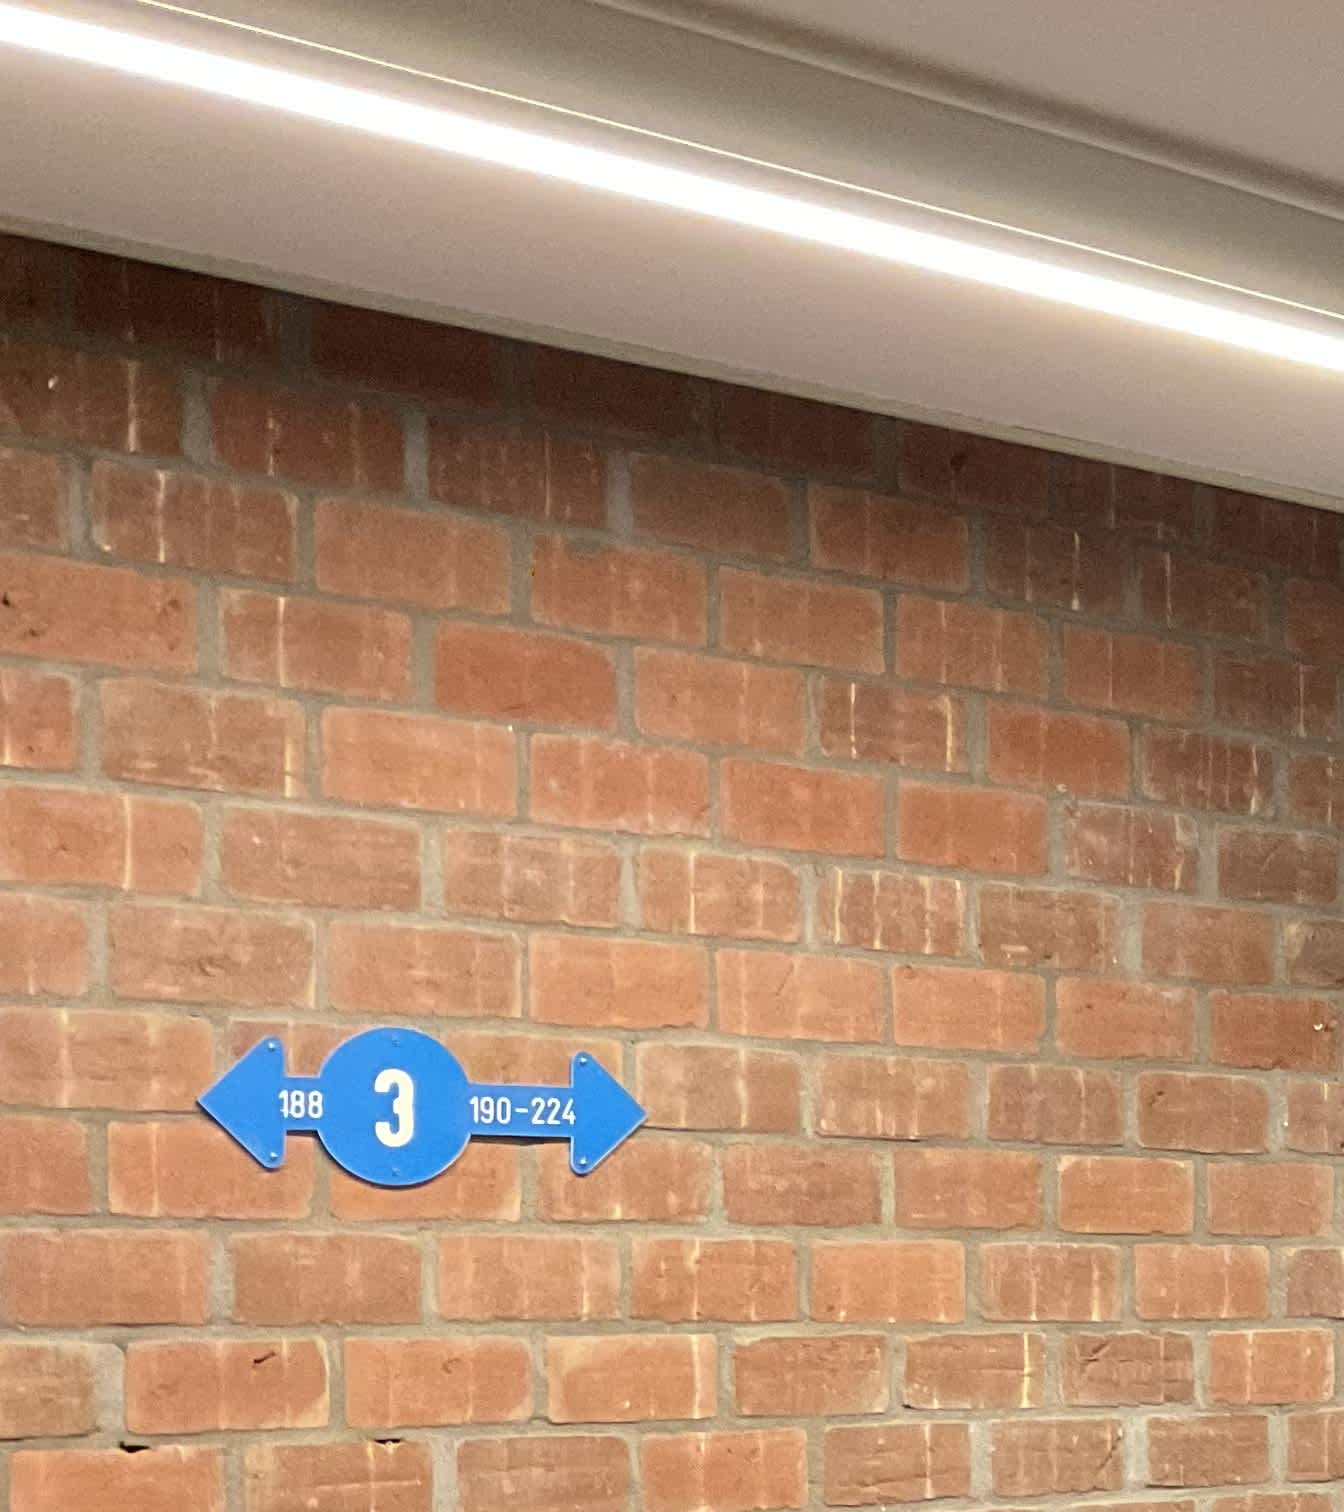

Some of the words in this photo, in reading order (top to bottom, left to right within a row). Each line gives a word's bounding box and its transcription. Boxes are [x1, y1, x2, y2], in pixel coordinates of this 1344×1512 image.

[278, 1089, 324, 1120] 188
[374, 1068, 415, 1148] 3
[469, 1096, 577, 1126] 190-224
